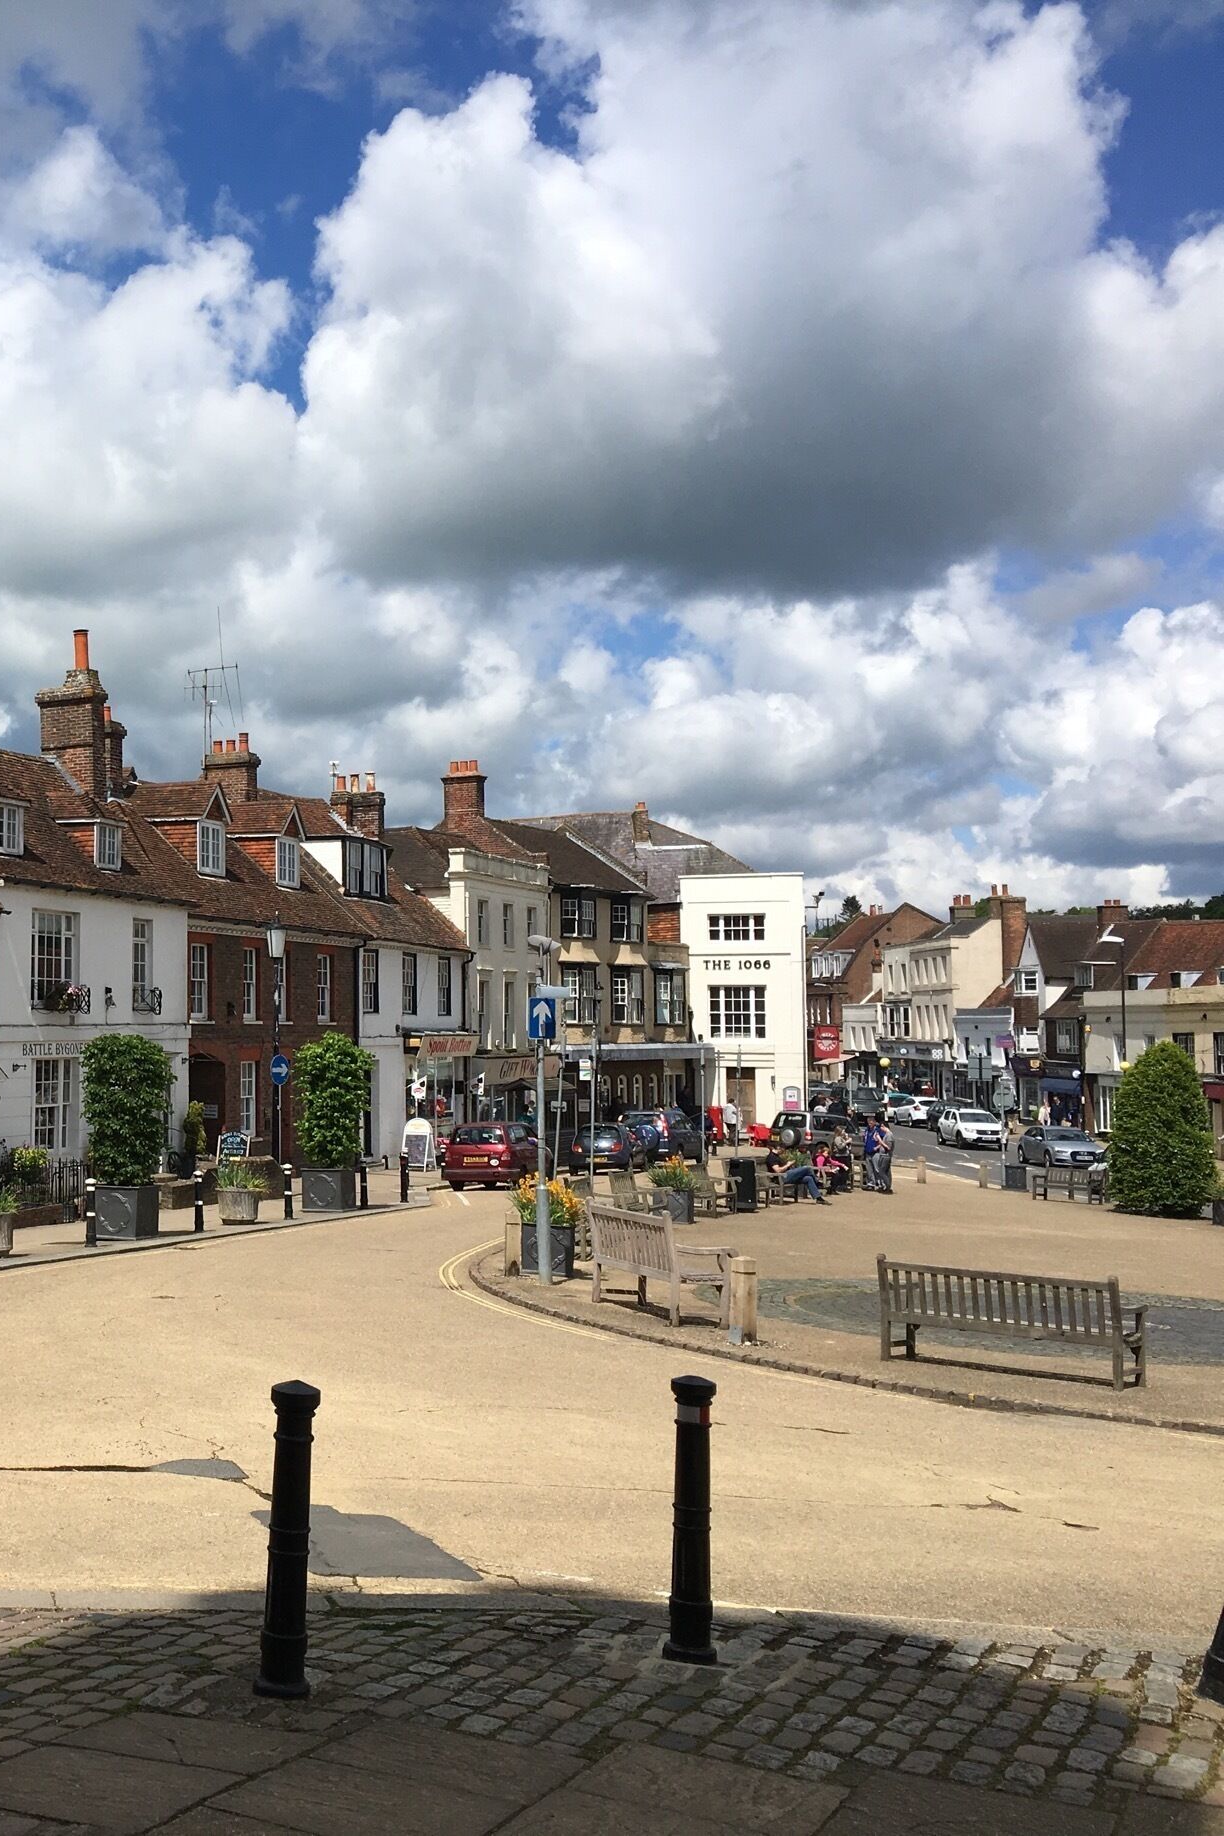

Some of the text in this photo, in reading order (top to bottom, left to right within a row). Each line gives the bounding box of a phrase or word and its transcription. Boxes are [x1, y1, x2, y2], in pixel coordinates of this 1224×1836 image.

[702, 959, 772, 970] THE 1066
[22, 1043, 53, 1056] BATTLE
[499, 1060, 520, 1079] GIFT
